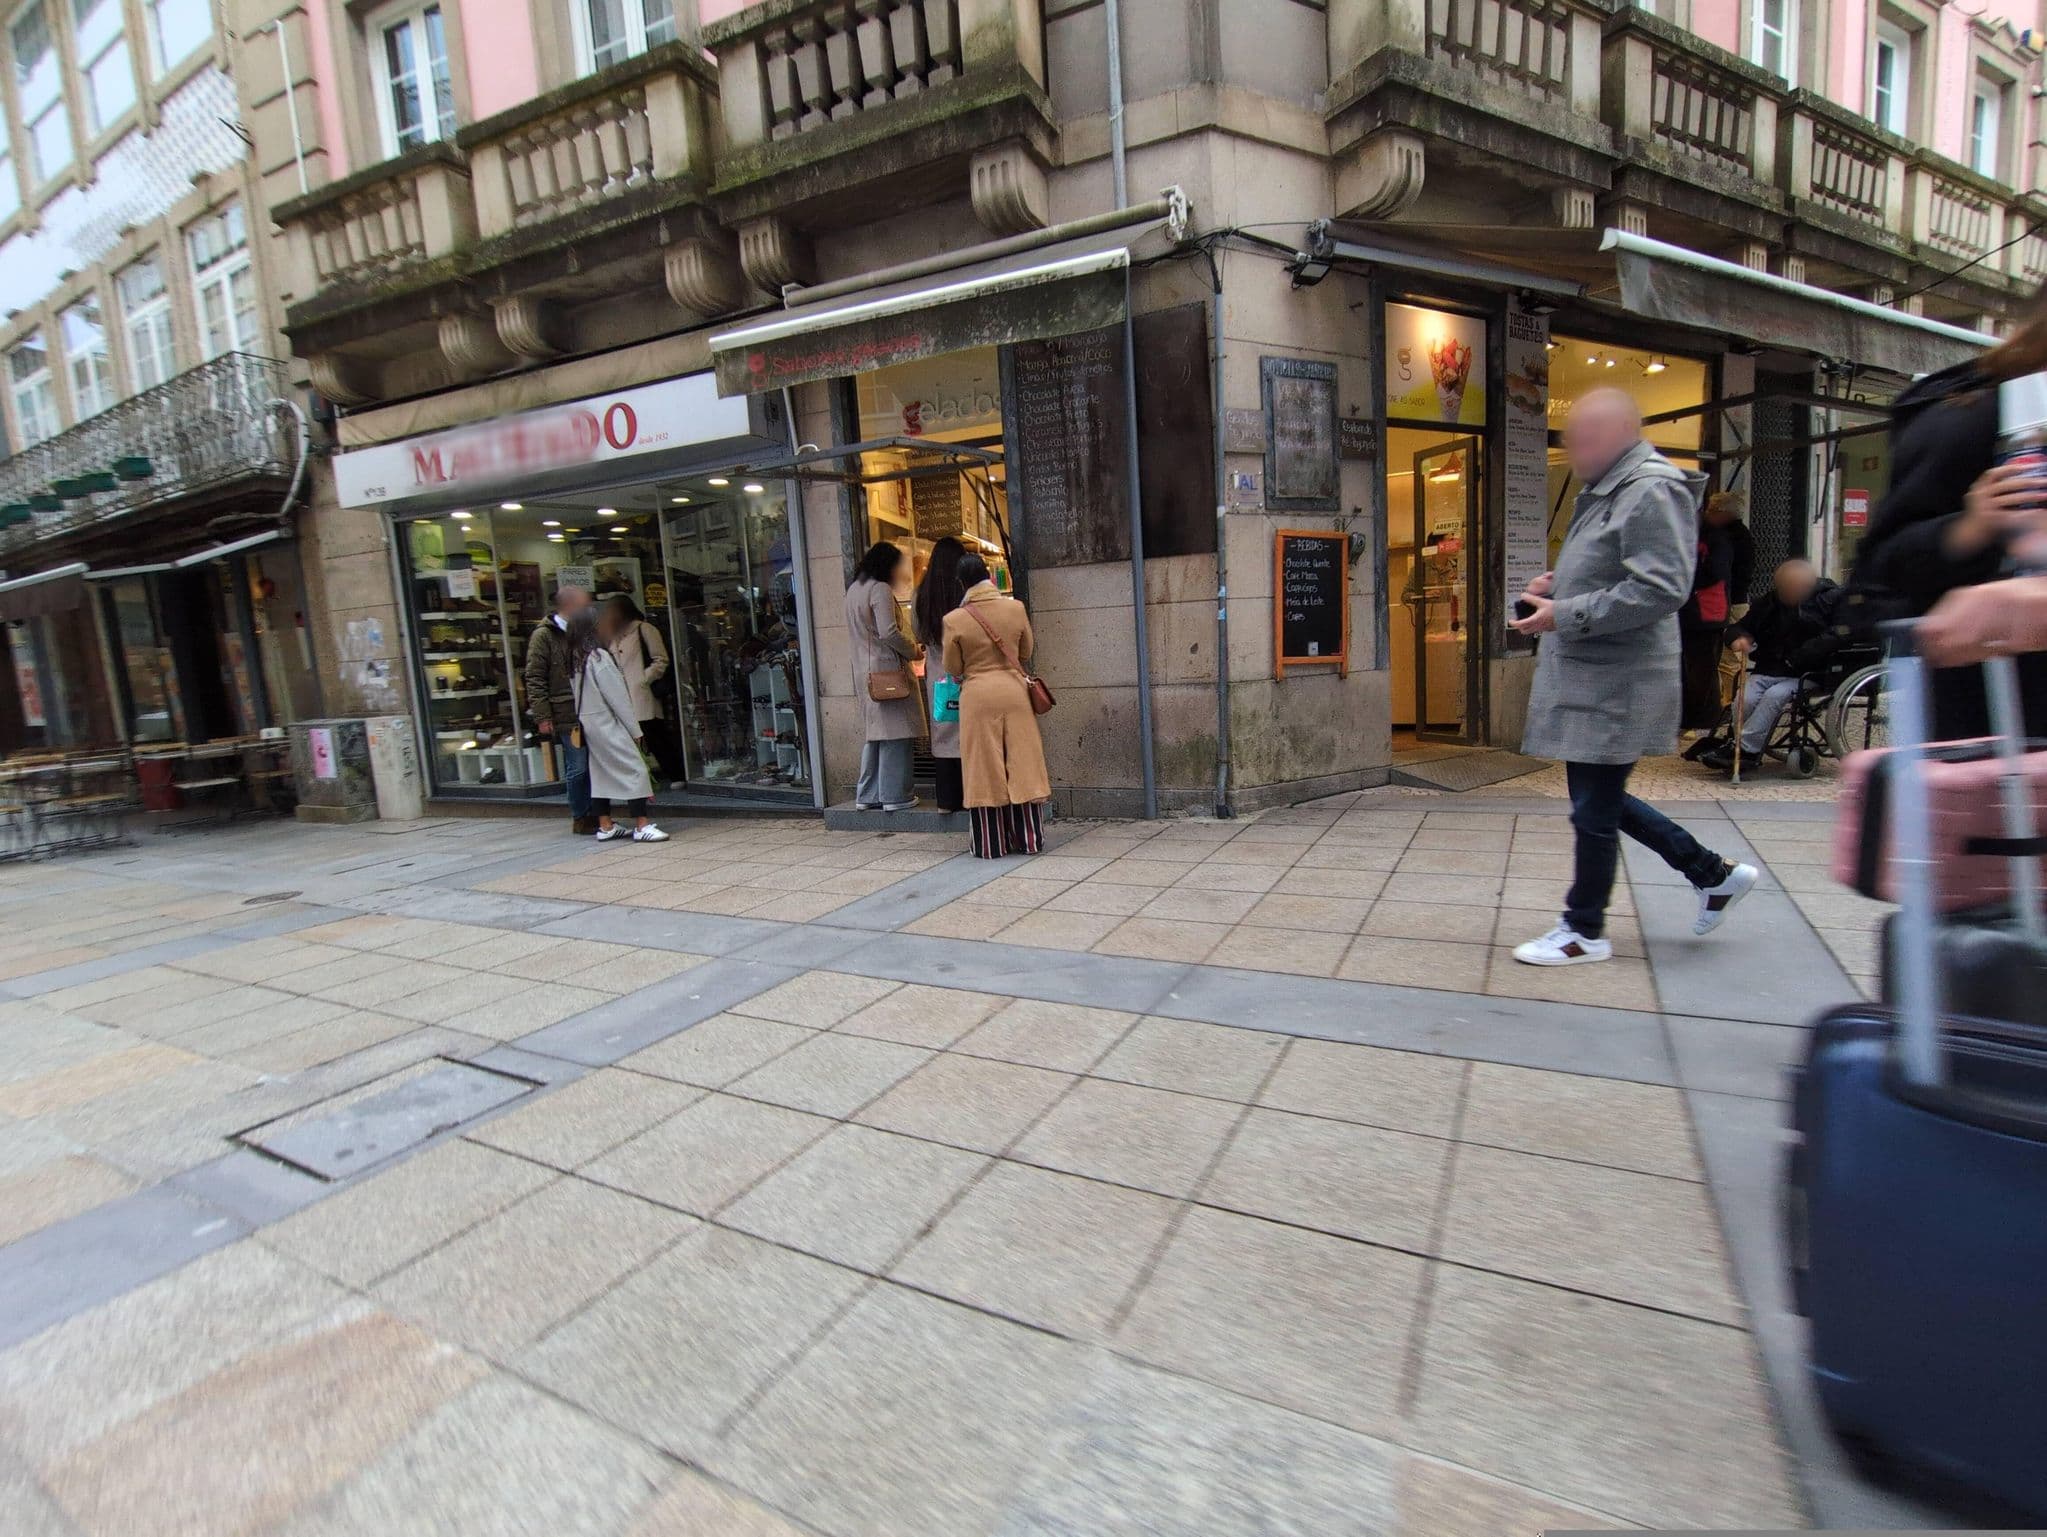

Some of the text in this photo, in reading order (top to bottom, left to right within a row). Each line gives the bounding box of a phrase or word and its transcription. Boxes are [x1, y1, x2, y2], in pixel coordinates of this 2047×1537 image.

[1509, 312, 1535, 330] TOSTAS
[1509, 325, 1544, 344] BAGUETES
[1239, 475, 1258, 491] AL
[1435, 521, 1460, 530] ABERTO
